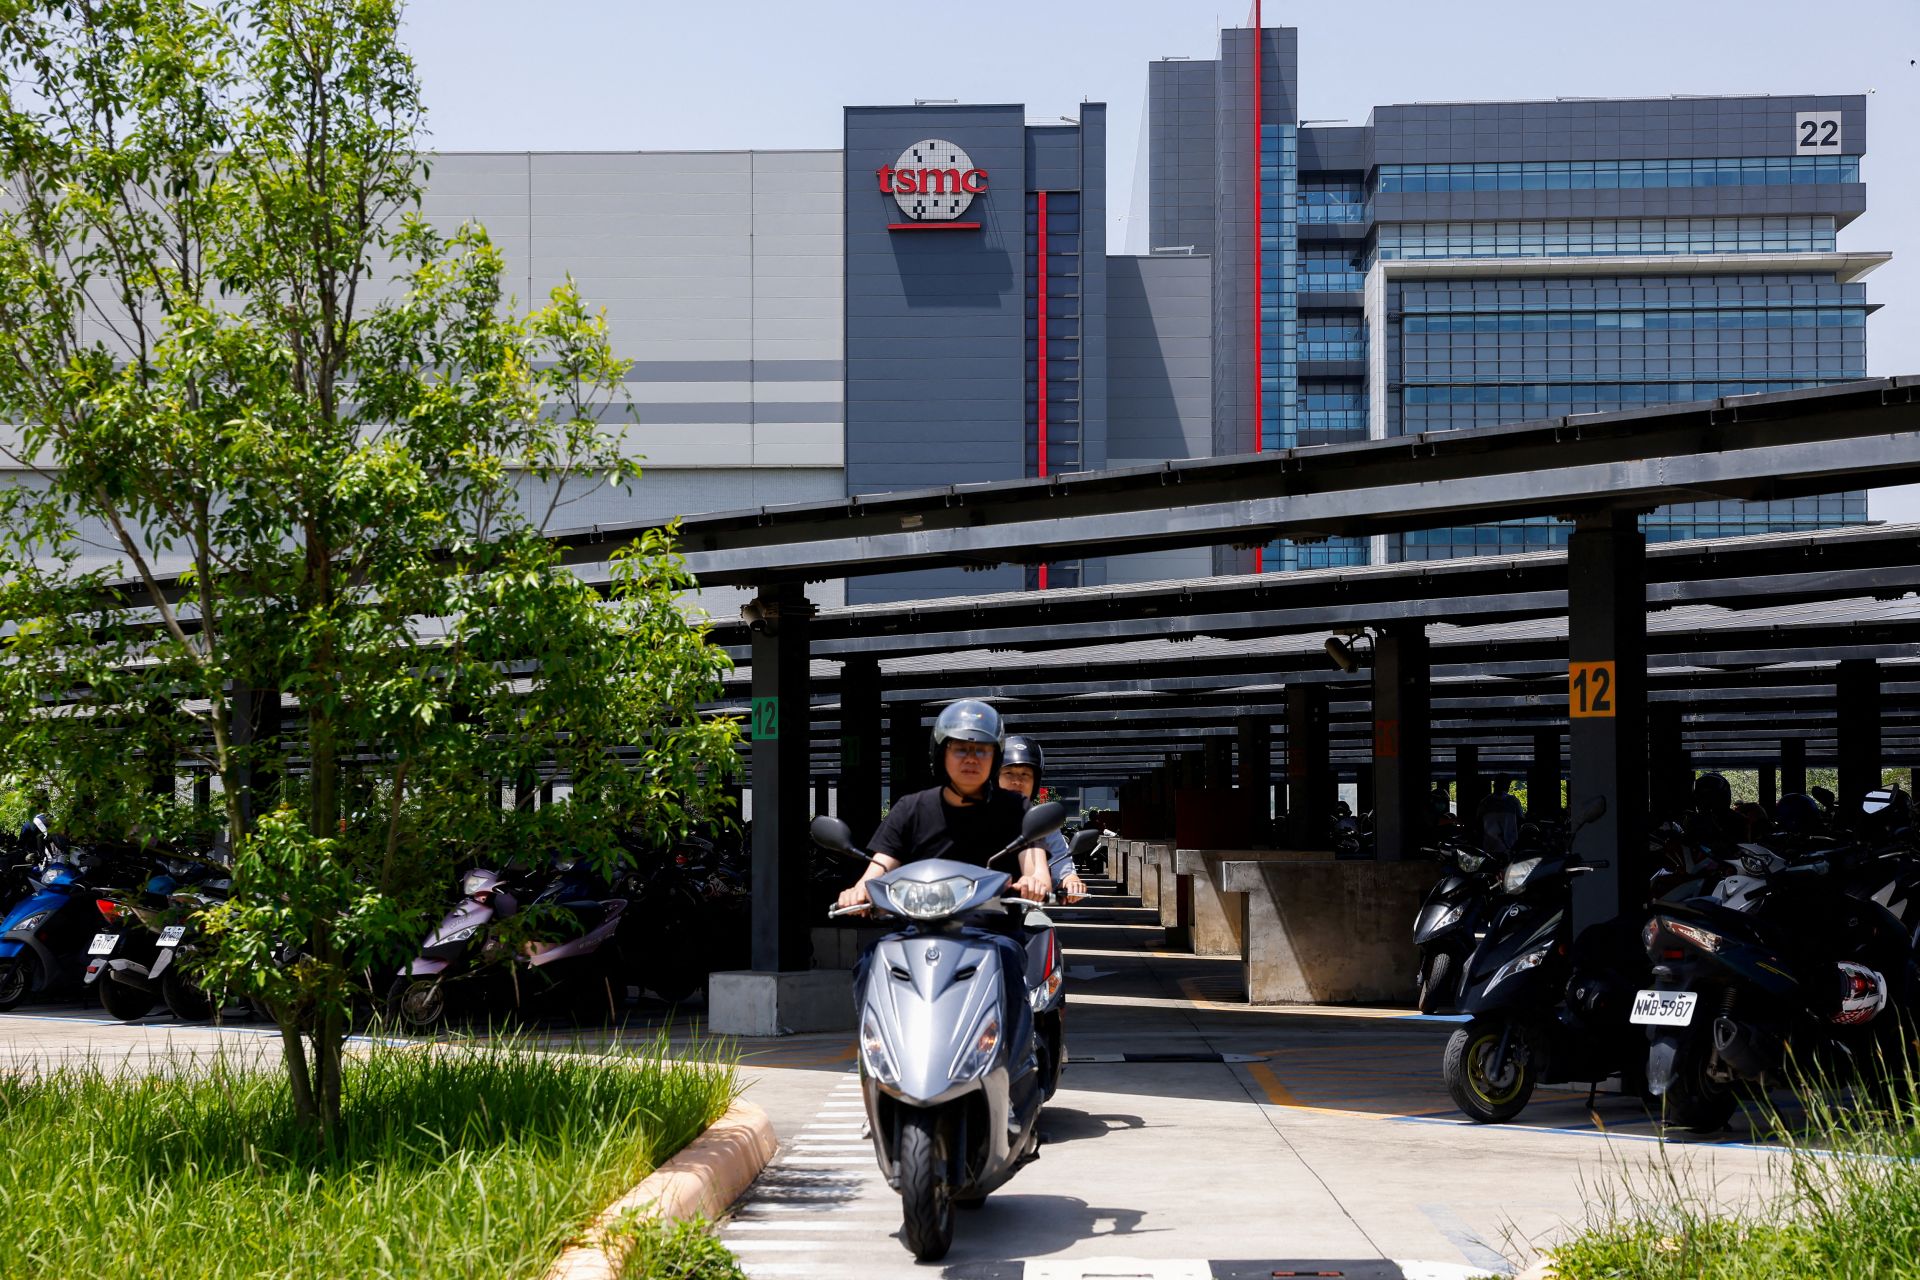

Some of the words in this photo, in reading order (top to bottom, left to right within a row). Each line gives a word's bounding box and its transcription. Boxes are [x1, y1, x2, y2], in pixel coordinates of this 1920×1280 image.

[1800, 120, 1838, 147] 22
[876, 164, 989, 195] tsmc
[1572, 667, 1611, 713] 12
[754, 701, 776, 736] 12
